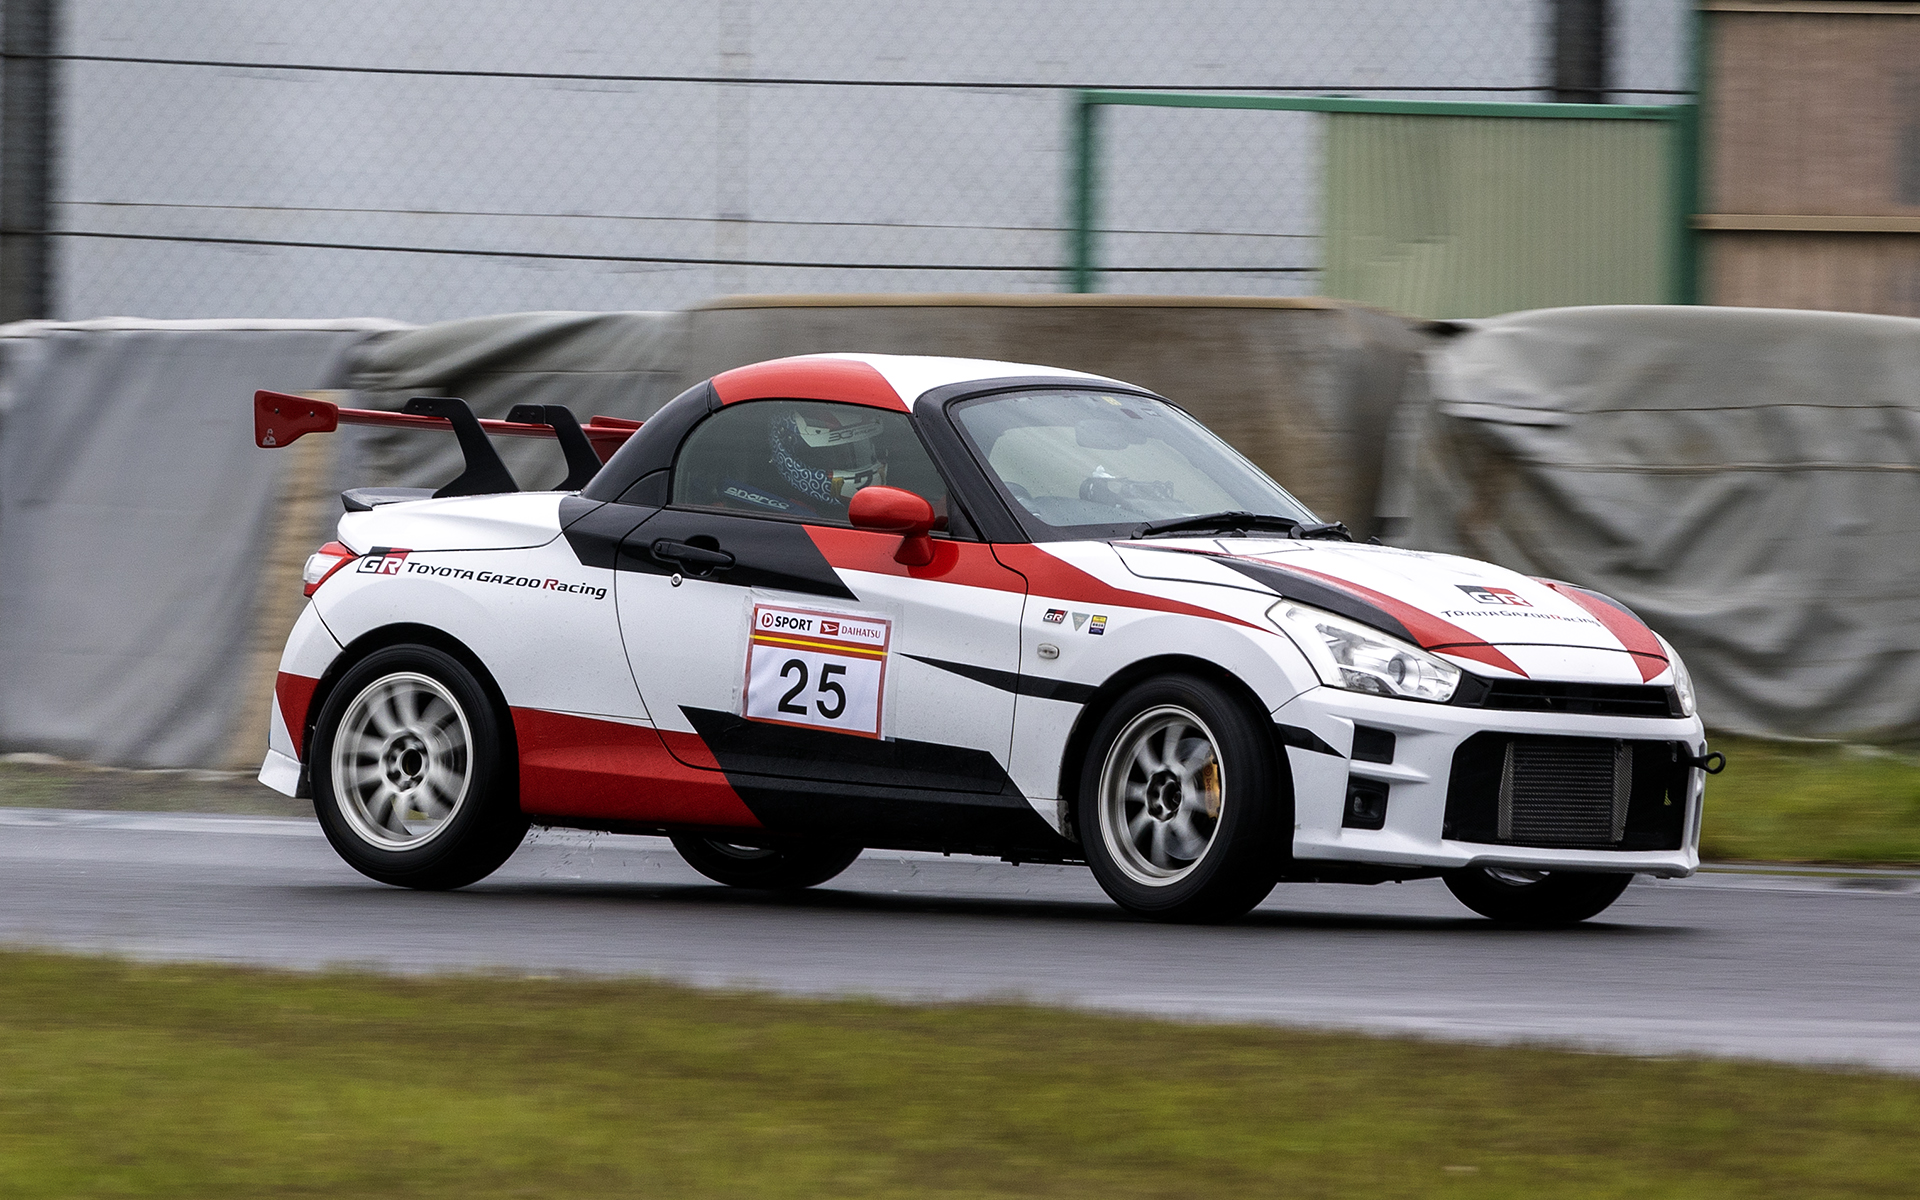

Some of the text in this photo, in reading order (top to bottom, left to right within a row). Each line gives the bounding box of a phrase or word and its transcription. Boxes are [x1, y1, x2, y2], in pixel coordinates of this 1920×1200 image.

[724, 487, 790, 510] sparco
[358, 555, 607, 600] GR TOYOTA GAZOO Racing
[1468, 591, 1531, 606] GR
[1441, 610, 1499, 618] TOYOTA
[774, 616, 813, 632] SPORT
[841, 625, 881, 639] DAIHATSU
[778, 658, 847, 719] 25
